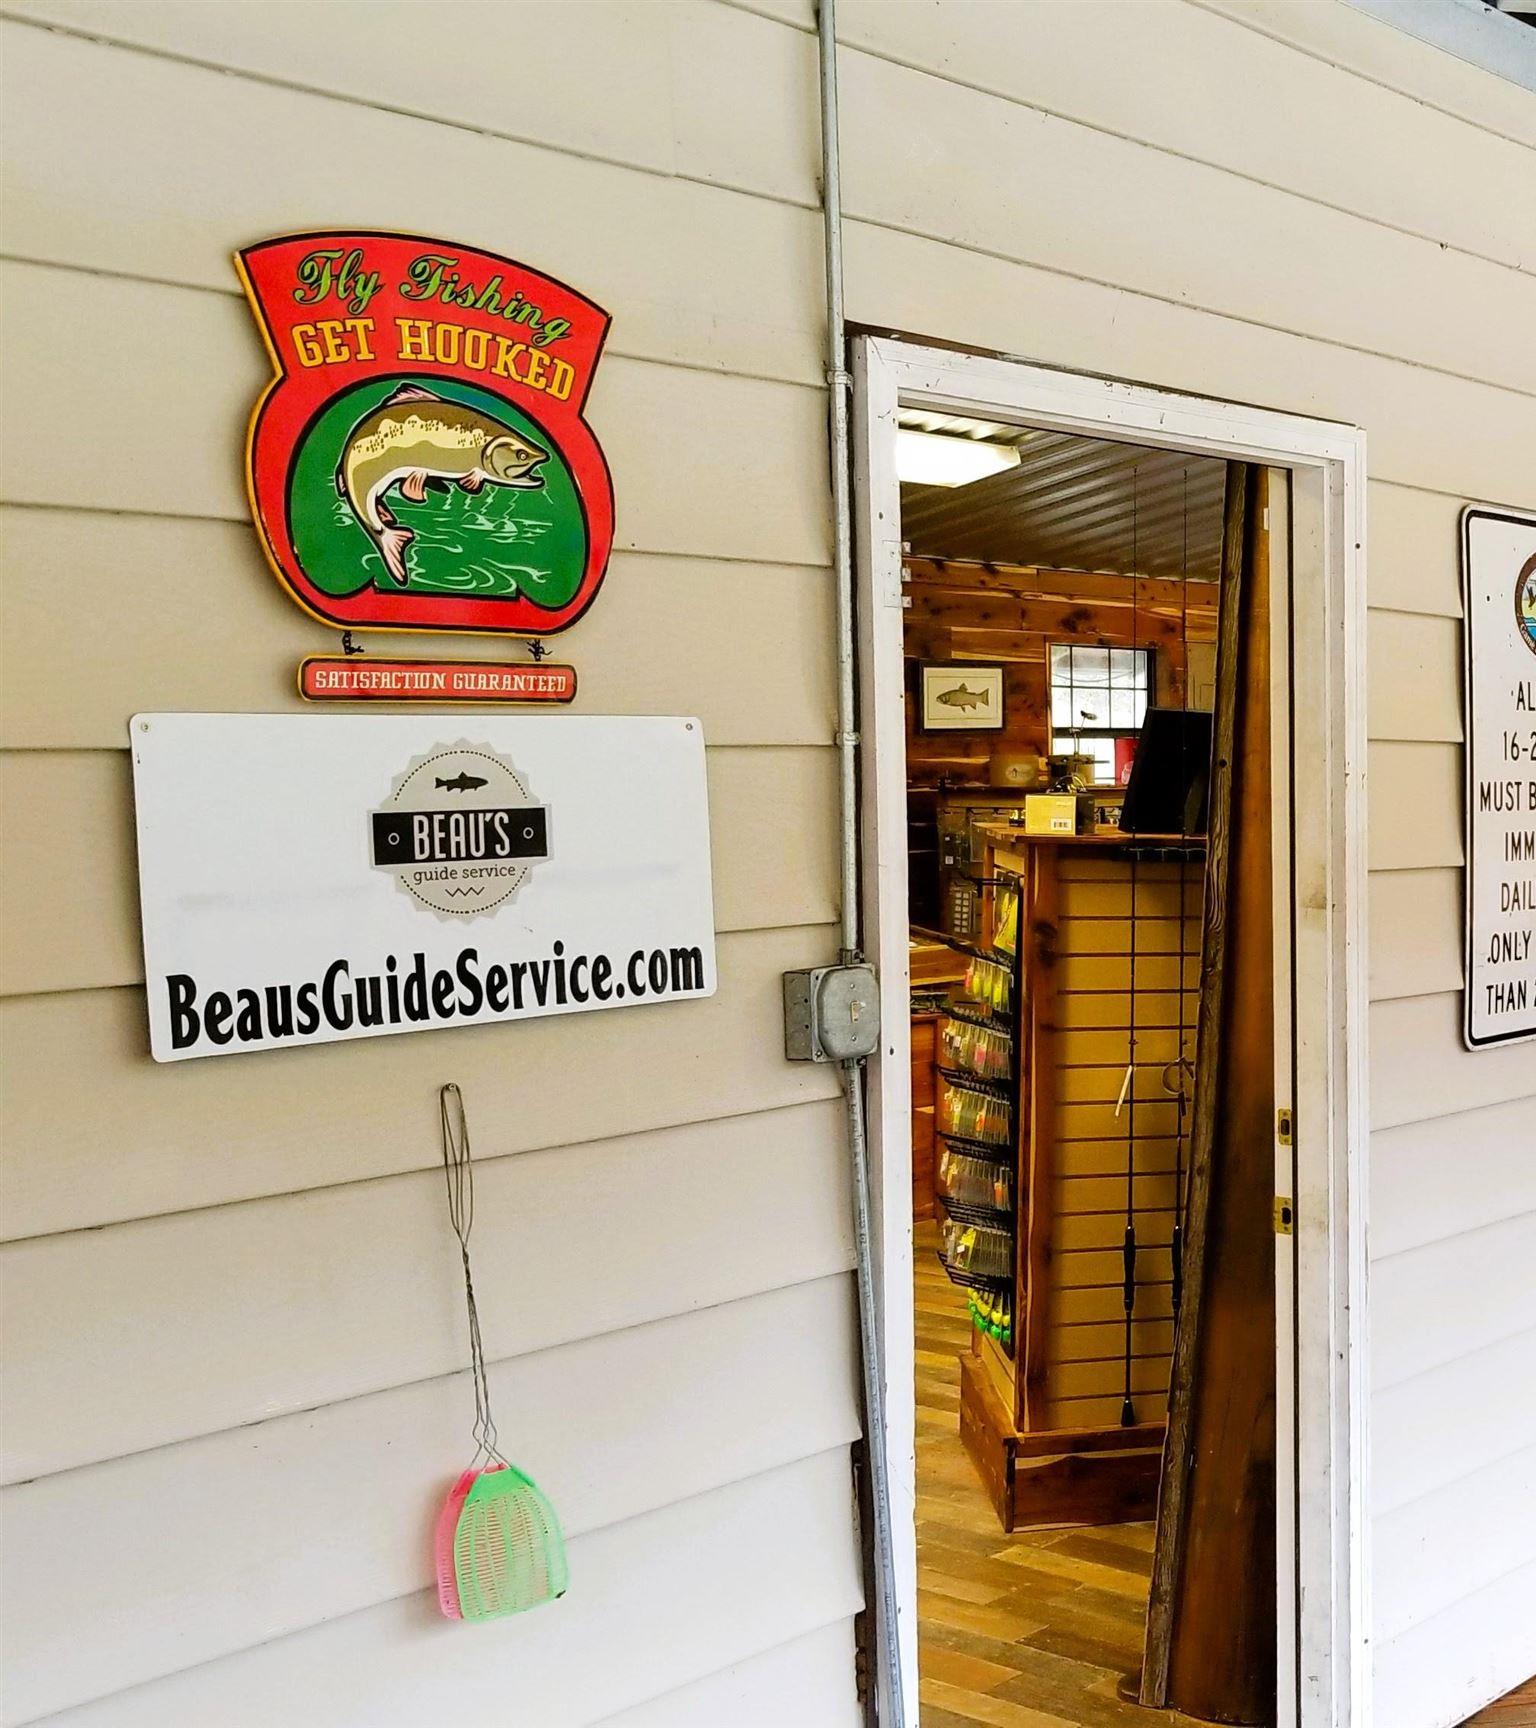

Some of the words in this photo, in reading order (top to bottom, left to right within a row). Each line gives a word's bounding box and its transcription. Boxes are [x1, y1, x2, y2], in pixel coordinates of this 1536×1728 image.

[293, 248, 385, 314] Fly
[399, 252, 573, 346] Fishing
[291, 317, 376, 368] GET
[394, 317, 576, 402] HOOKED
[315, 669, 446, 690] SATISFACTION
[452, 672, 567, 693] GUARANTEED
[1480, 781, 1522, 812] MUST
[412, 811, 511, 861] BEAU'S
[413, 865, 459, 886] guide
[462, 864, 516, 880] service
[165, 940, 705, 1050] BeausGuideService.com
[1486, 980, 1527, 1015] THAN
